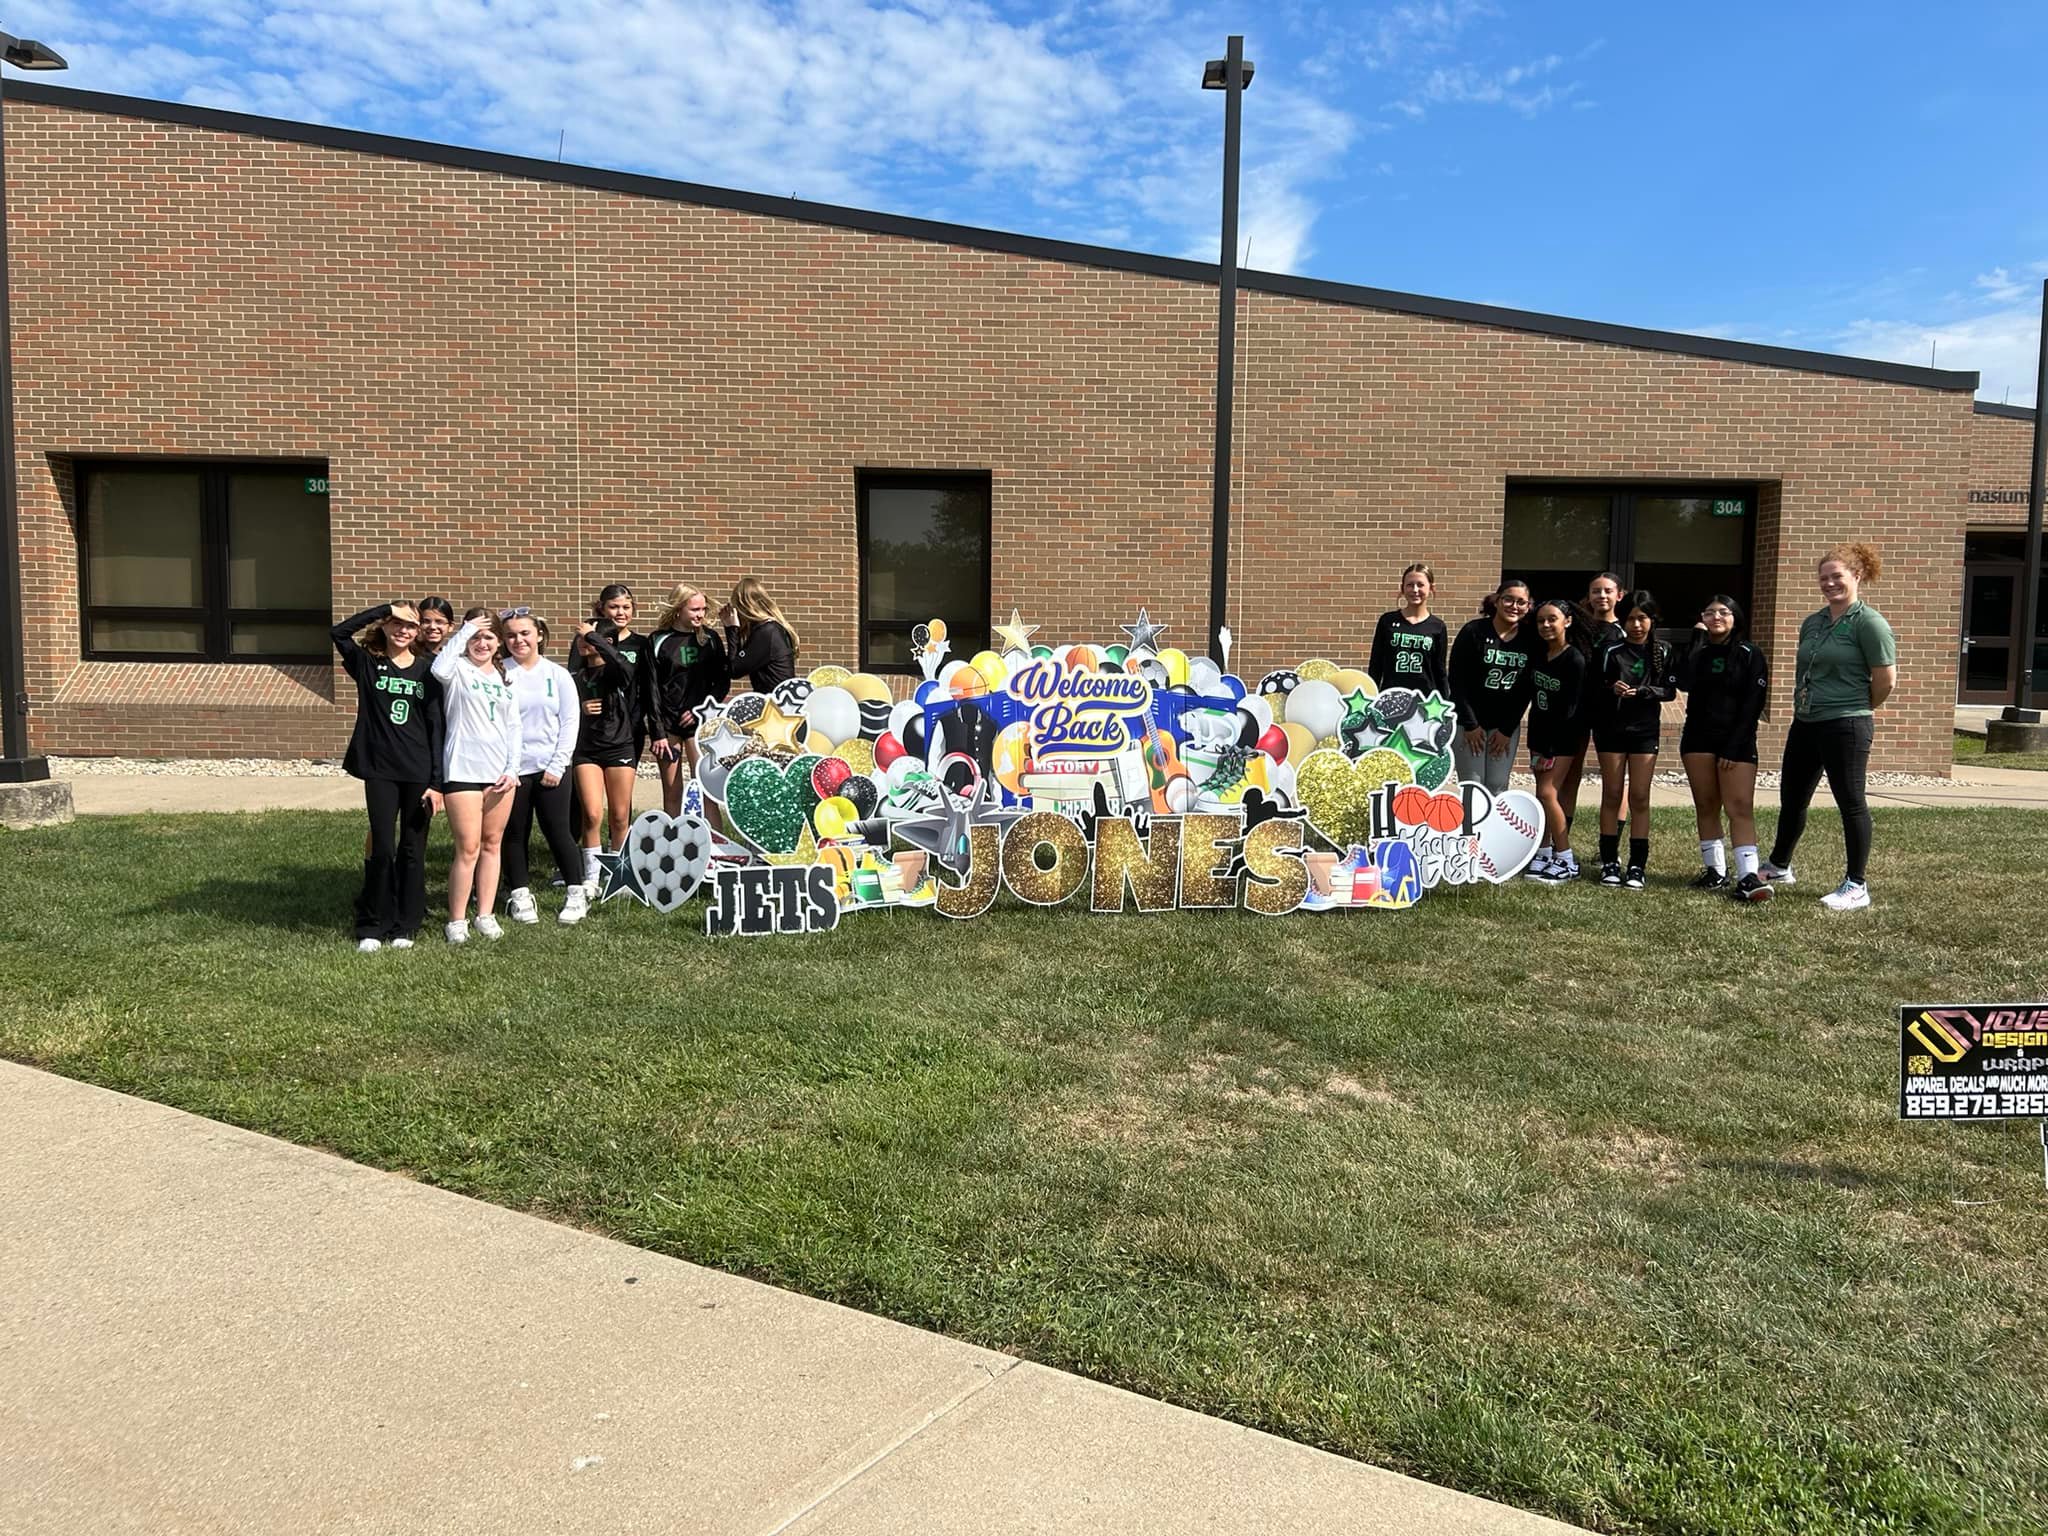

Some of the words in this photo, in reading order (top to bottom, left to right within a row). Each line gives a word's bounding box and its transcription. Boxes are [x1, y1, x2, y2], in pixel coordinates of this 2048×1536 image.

[1968, 486, 2030, 504] nasium
[1716, 501, 1743, 514] 304
[1391, 632, 1433, 650] JETS
[1395, 651, 1424, 673] 22
[1483, 649, 1529, 668] JETS
[375, 675, 425, 700] JETS
[544, 678, 554, 698] 1
[1010, 661, 1147, 712] Welcome
[1484, 668, 1519, 690] 24
[390, 699, 409, 725] 9
[488, 700, 496, 722] 1
[1034, 700, 1125, 754] Back
[935, 812, 1309, 918] JONES
[706, 864, 842, 937] JETS
[1906, 1077, 1949, 1093] APPAREL
[1950, 1076, 1985, 1093] DECALS
[1986, 1075, 1999, 1088] AND
[2000, 1075, 2026, 1092] MUCH
